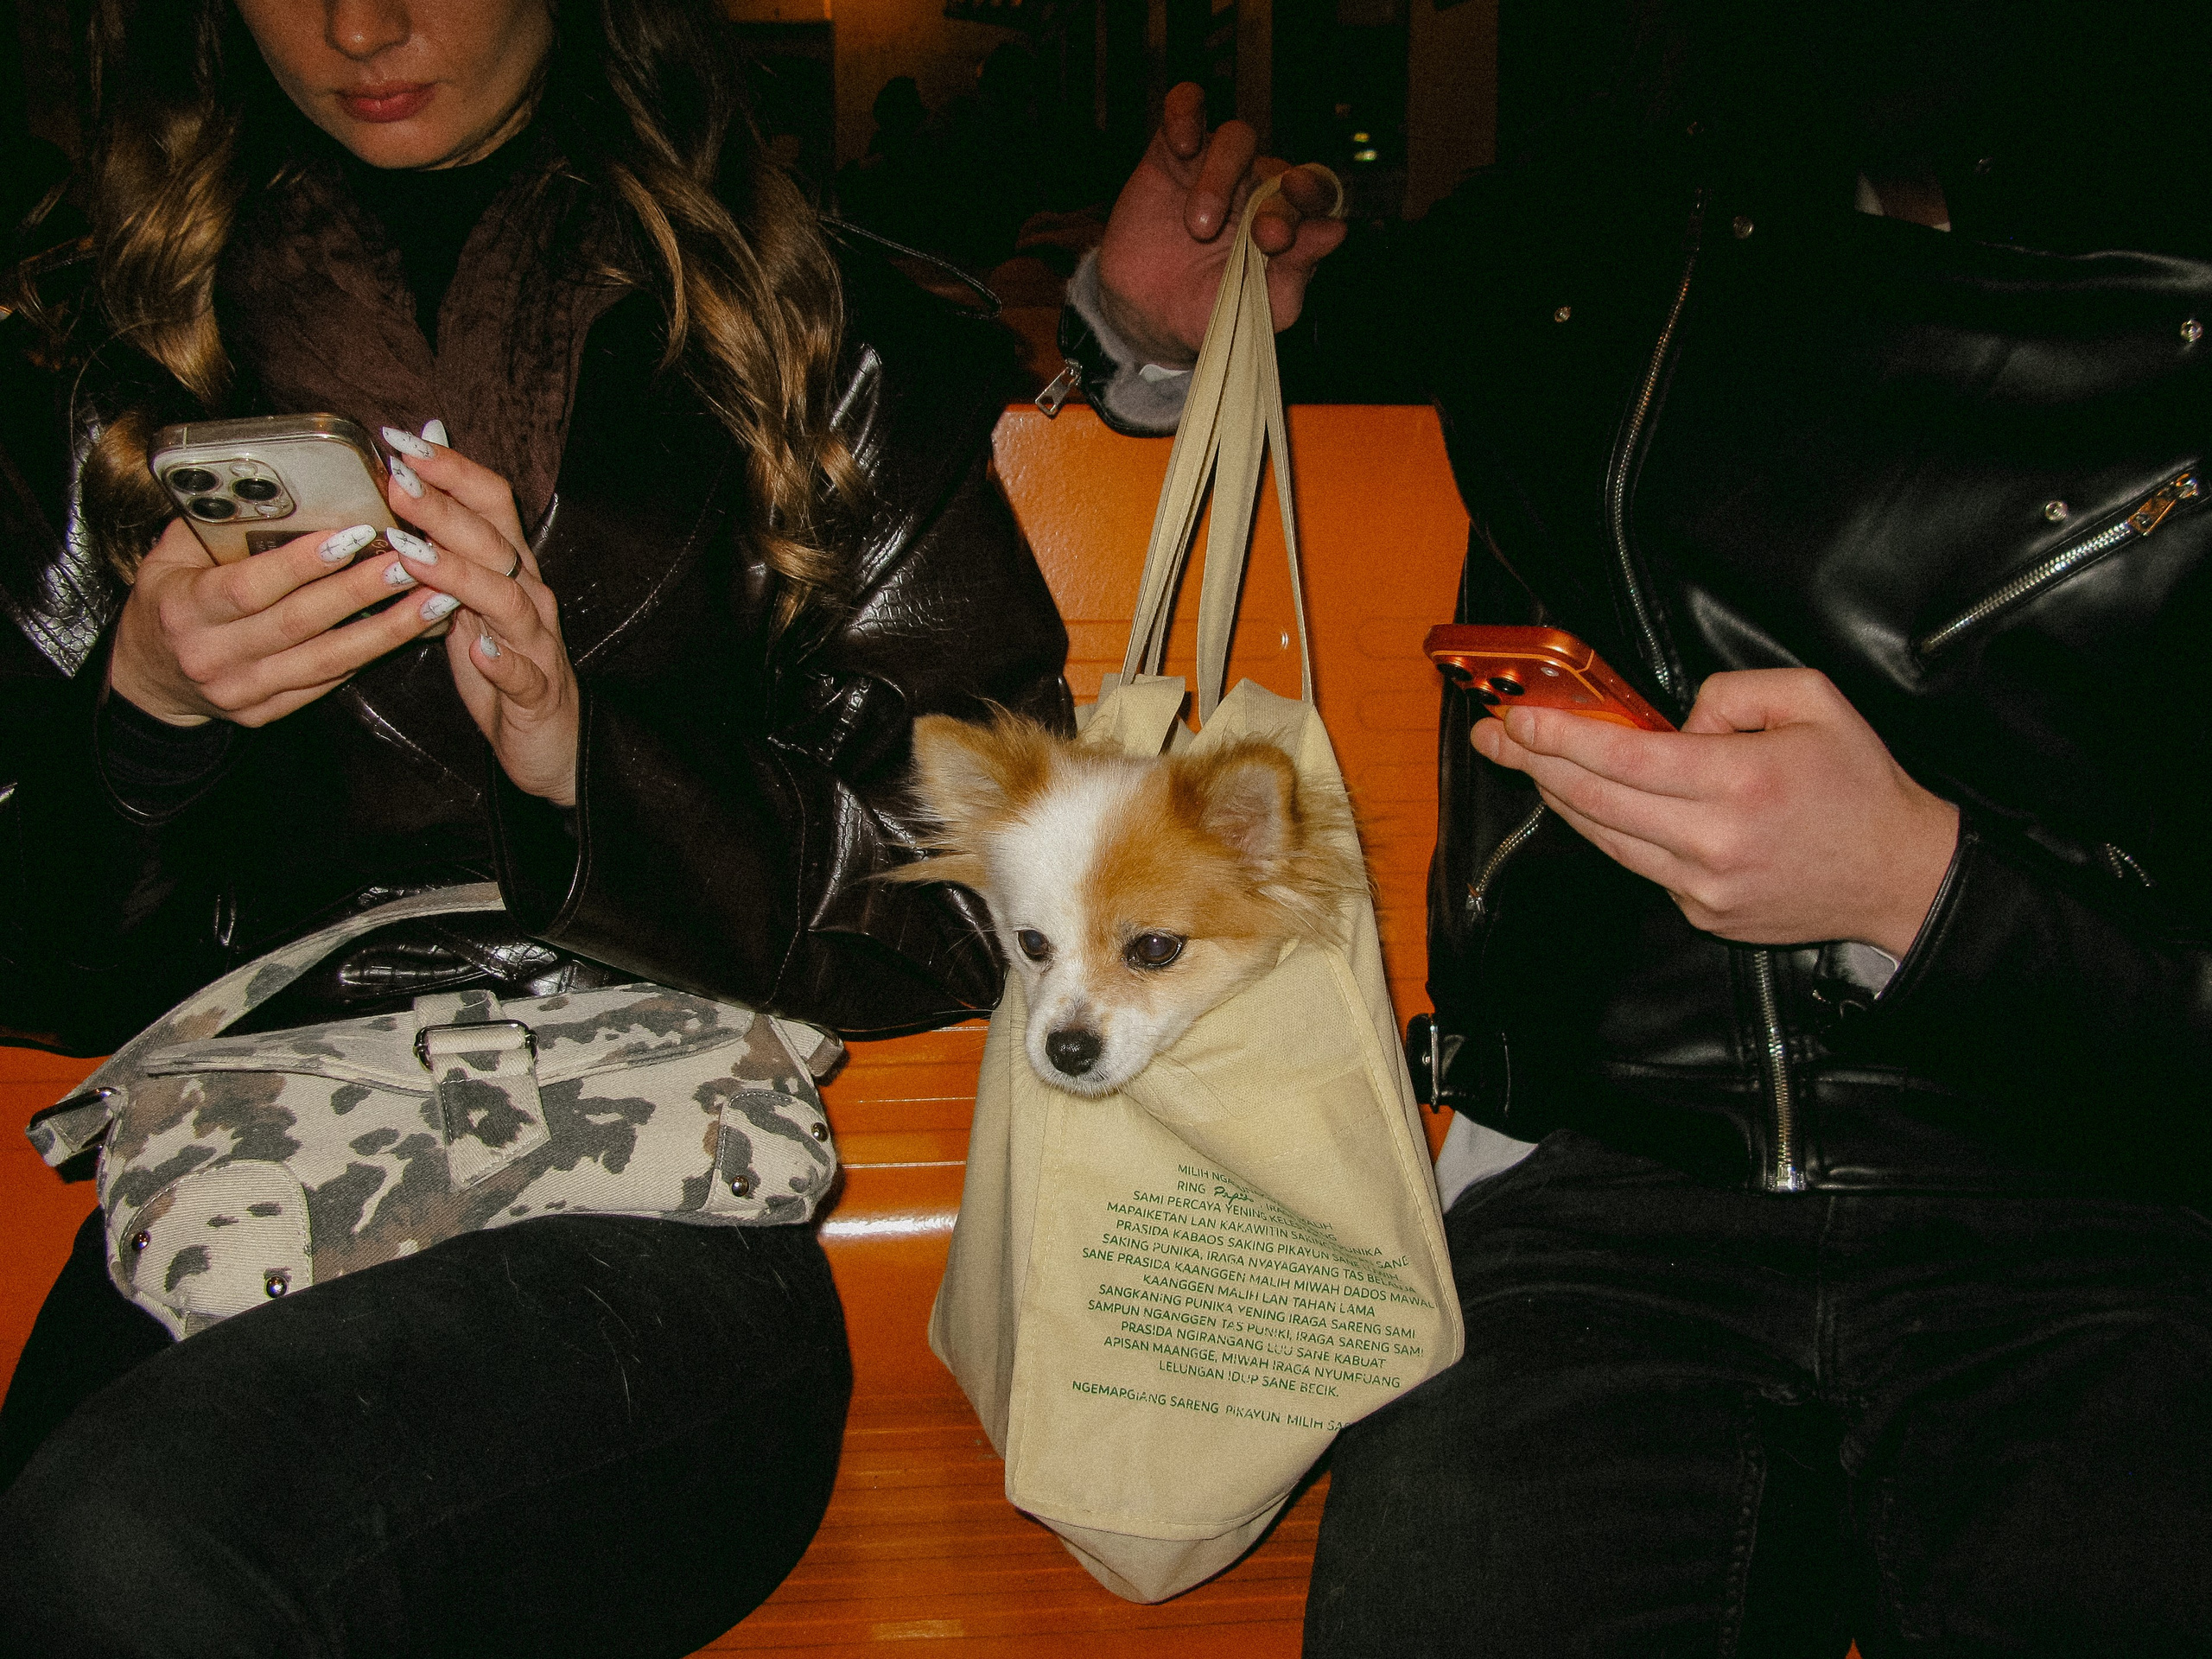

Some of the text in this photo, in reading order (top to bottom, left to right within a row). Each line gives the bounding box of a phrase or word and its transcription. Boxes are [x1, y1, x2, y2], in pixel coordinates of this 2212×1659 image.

[1178, 1164, 1208, 1178] MILIH
[1178, 1180, 1205, 1193] RING
[1107, 1202, 1187, 1224] MAPAIKETAN
[1191, 1217, 1216, 1228] LAN
[1220, 1221, 1287, 1237] KAKAWITIN
[1134, 1191, 1163, 1204] SAMI
[1167, 1196, 1221, 1212] PERCAYA
[1226, 1205, 1267, 1221] YENING
[1103, 1233, 1148, 1251] SAKING
[1153, 1243, 1202, 1260] PUNIKA,
[1207, 1251, 1244, 1266] IRAGA
[1249, 1257, 1338, 1277] NYAYAGAYANG
[1344, 1269, 1363, 1281] TAS
[1116, 1220, 1168, 1237] PRASIDA
[1173, 1230, 1224, 1246] KABAOS
[1228, 1237, 1274, 1253] SAKING
[1278, 1244, 1329, 1259] PIKAYUN
[1083, 1248, 1114, 1262] SANE
[1117, 1253, 1170, 1270] PRASIDA
[1175, 1262, 1245, 1282] KAANGGEN
[1249, 1274, 1290, 1288] MALIH
[1294, 1281, 1339, 1294] MIWAH
[1344, 1286, 1386, 1300] DADOS
[1099, 1284, 1414, 1338] SANGKANING PUNIKA YENING IRAGA SARENG SAMI
[1143, 1274, 1375, 1317] KAANGGEN MALIH LAN TAHAN LAMA
[1088, 1300, 1140, 1316] SAMPUN
[1144, 1308, 1216, 1326] NGANGGEN
[1223, 1319, 1243, 1332] TAS
[1296, 1332, 1334, 1345] IRAGA
[1339, 1338, 1389, 1352] SARENG
[1394, 1344, 1423, 1356] SAMI
[1122, 1321, 1172, 1337] PRASIDA
[1177, 1329, 1263, 1351] NGIRANGANG
[1297, 1347, 1329, 1361] SANE
[1335, 1353, 1386, 1368] KABUAT
[1103, 1337, 1149, 1351] APISAN
[1153, 1343, 1217, 1363] MAANGGE,
[1222, 1352, 1268, 1369] MIWAH
[1273, 1361, 1310, 1375] IRAGA
[1160, 1361, 1338, 1397] LELUNGAN IDUP SANE BECIK.
[1171, 1396, 1218, 1414] SARENG
[1226, 1405, 1280, 1423] PIKAYUN
[1287, 1414, 1323, 1428] MILIH
